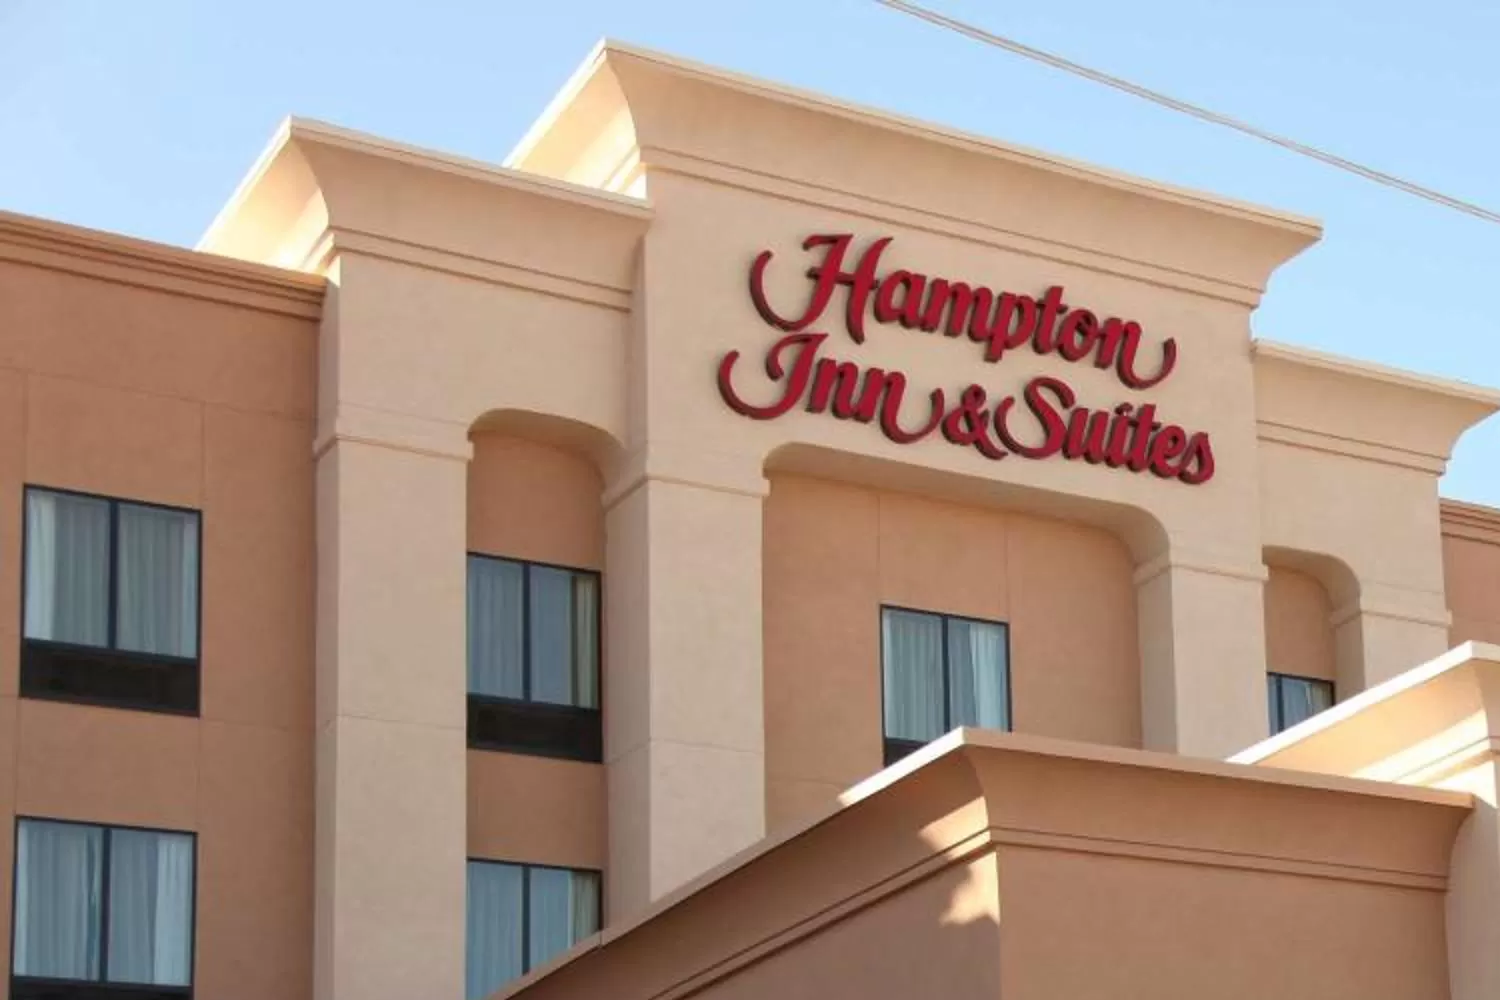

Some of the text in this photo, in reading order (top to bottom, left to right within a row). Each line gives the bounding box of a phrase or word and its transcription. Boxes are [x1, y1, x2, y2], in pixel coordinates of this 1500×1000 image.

[749, 233, 1177, 390] Hampton
[717, 333, 1216, 485] Inn & Suites
